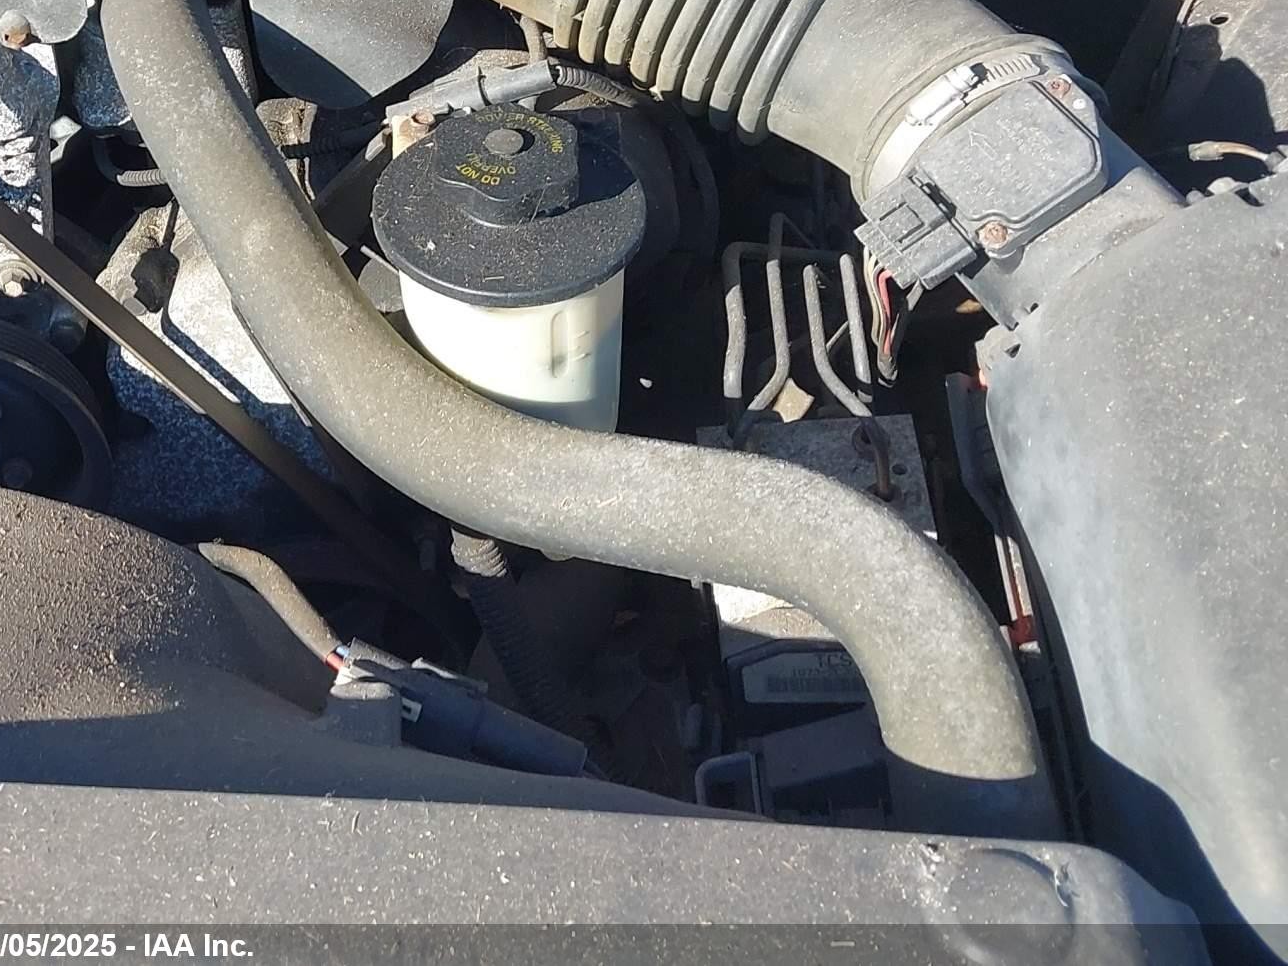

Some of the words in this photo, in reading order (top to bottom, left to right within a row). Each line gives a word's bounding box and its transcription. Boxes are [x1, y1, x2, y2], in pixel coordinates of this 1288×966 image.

[455, 162, 481, 180] NOT
[481, 175, 501, 186] DO
[816, 654, 852, 667] TCS
